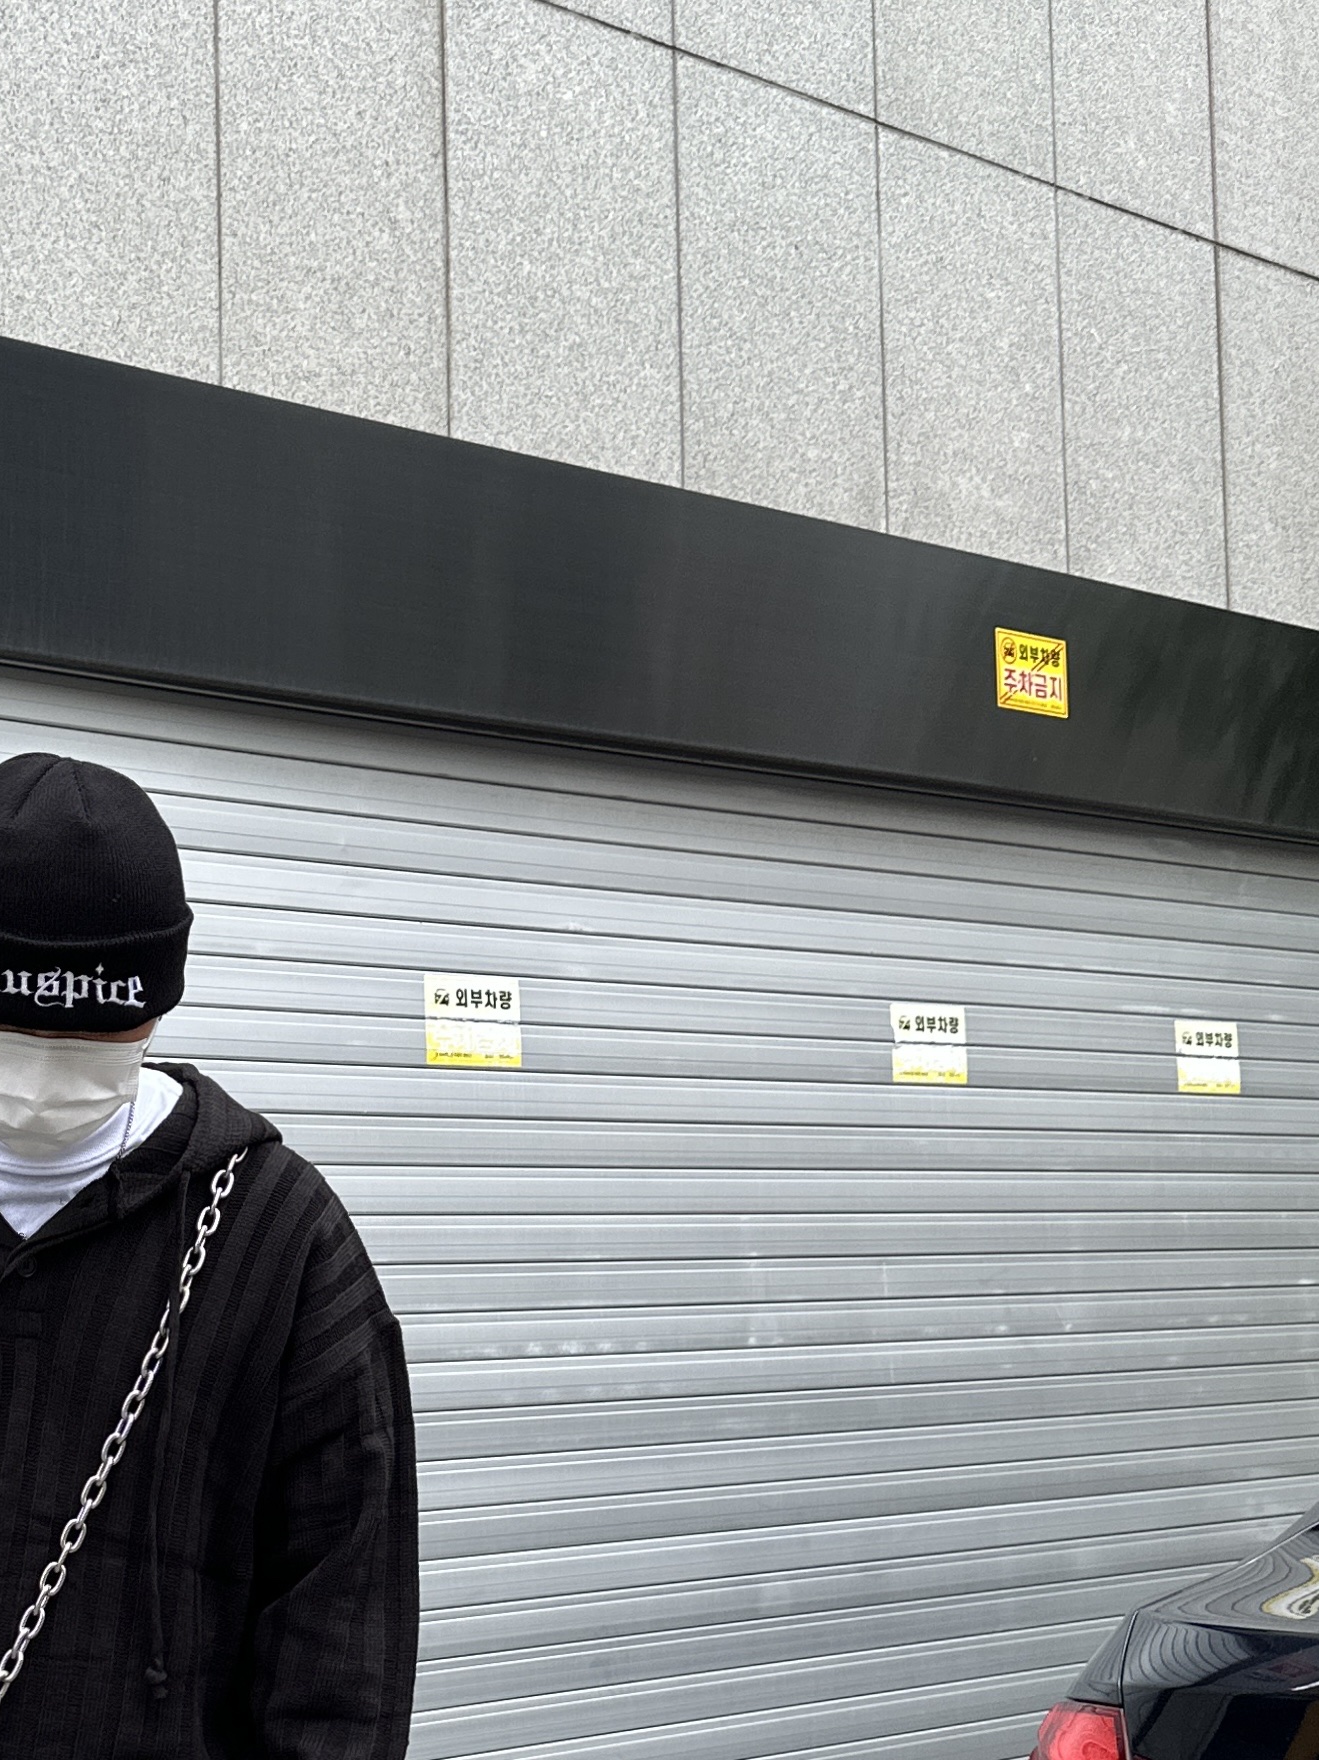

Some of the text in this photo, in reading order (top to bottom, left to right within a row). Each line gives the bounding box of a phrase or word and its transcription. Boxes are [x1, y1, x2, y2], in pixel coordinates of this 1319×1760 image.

[1019, 643, 1061, 668] 외부차량
[1003, 667, 1062, 702] 주차금지
[455, 988, 512, 1010] 외부차량
[915, 1015, 959, 1034] 외부차량
